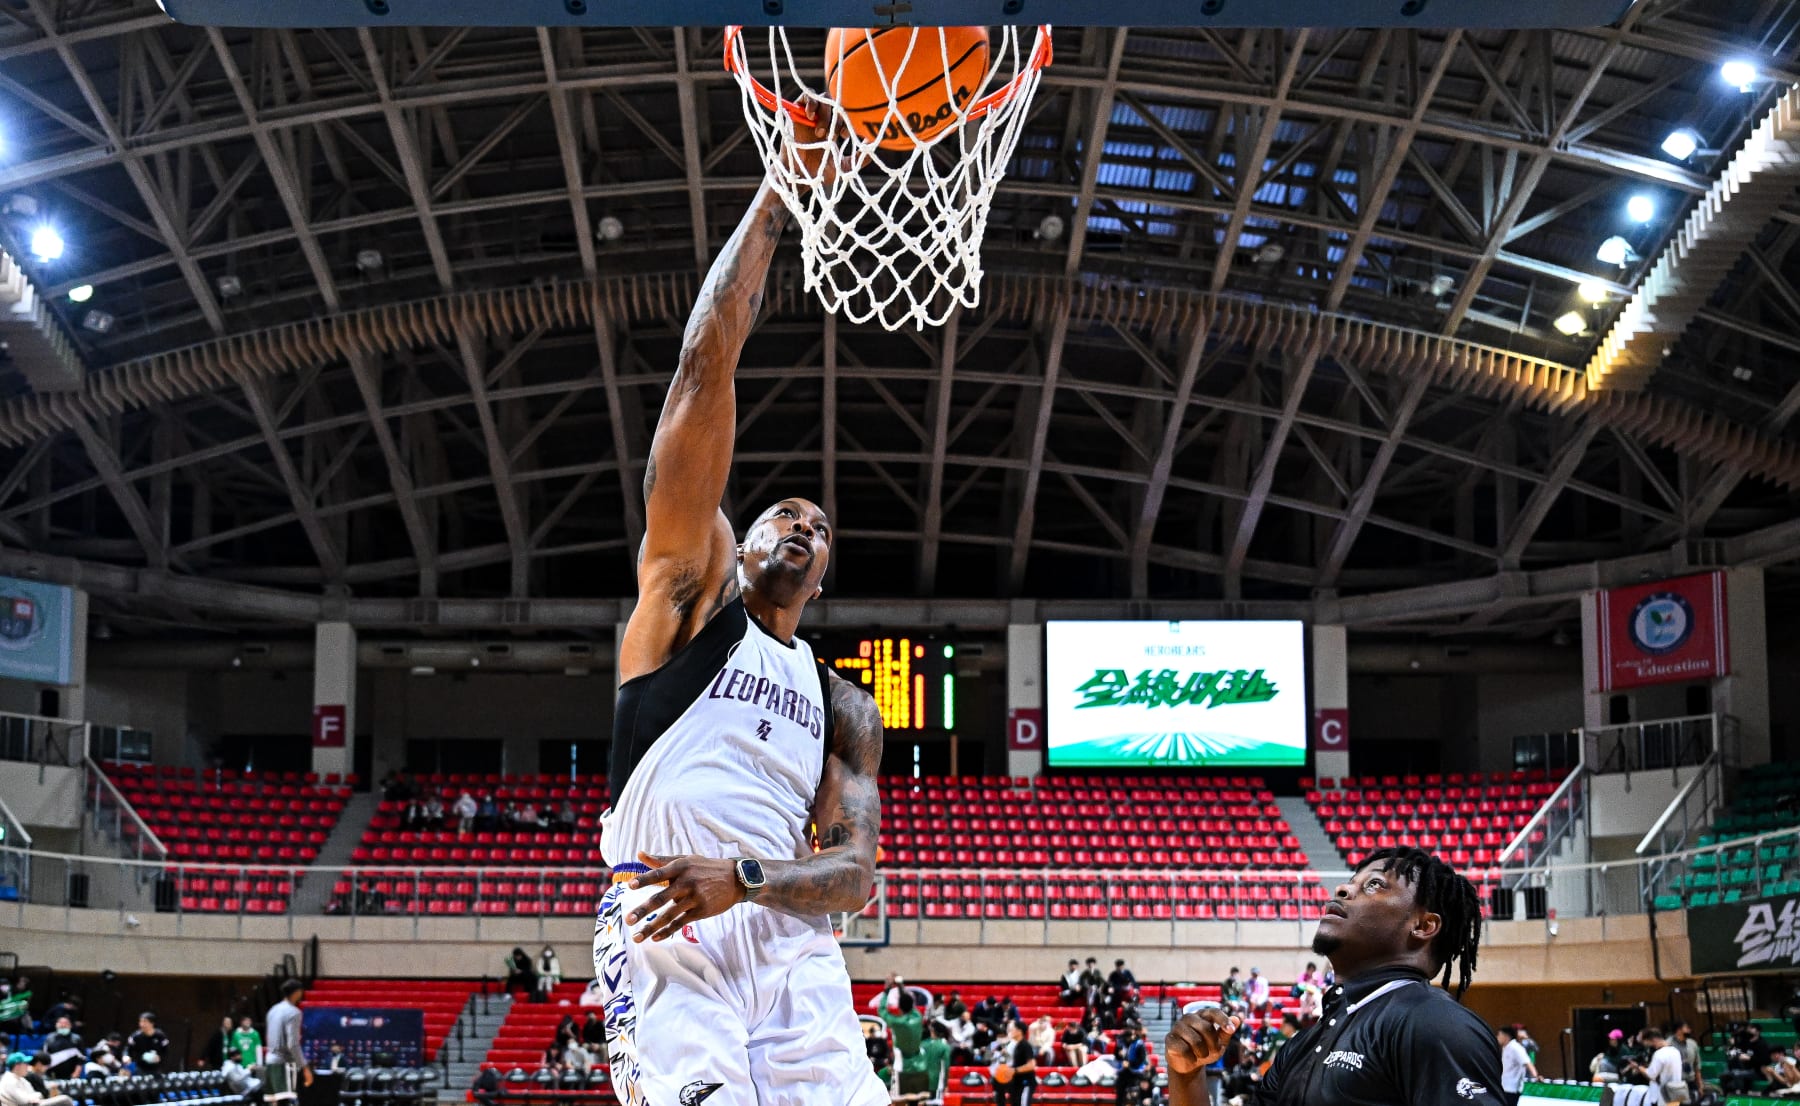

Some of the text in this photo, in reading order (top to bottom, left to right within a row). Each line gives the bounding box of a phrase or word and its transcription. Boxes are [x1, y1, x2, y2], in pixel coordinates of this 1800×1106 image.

[1637, 659, 1710, 678] Education
[708, 667, 824, 740] LEOPARDS
[320, 716, 340, 740] F
[1016, 719, 1037, 744] D
[1321, 719, 1341, 744] C
